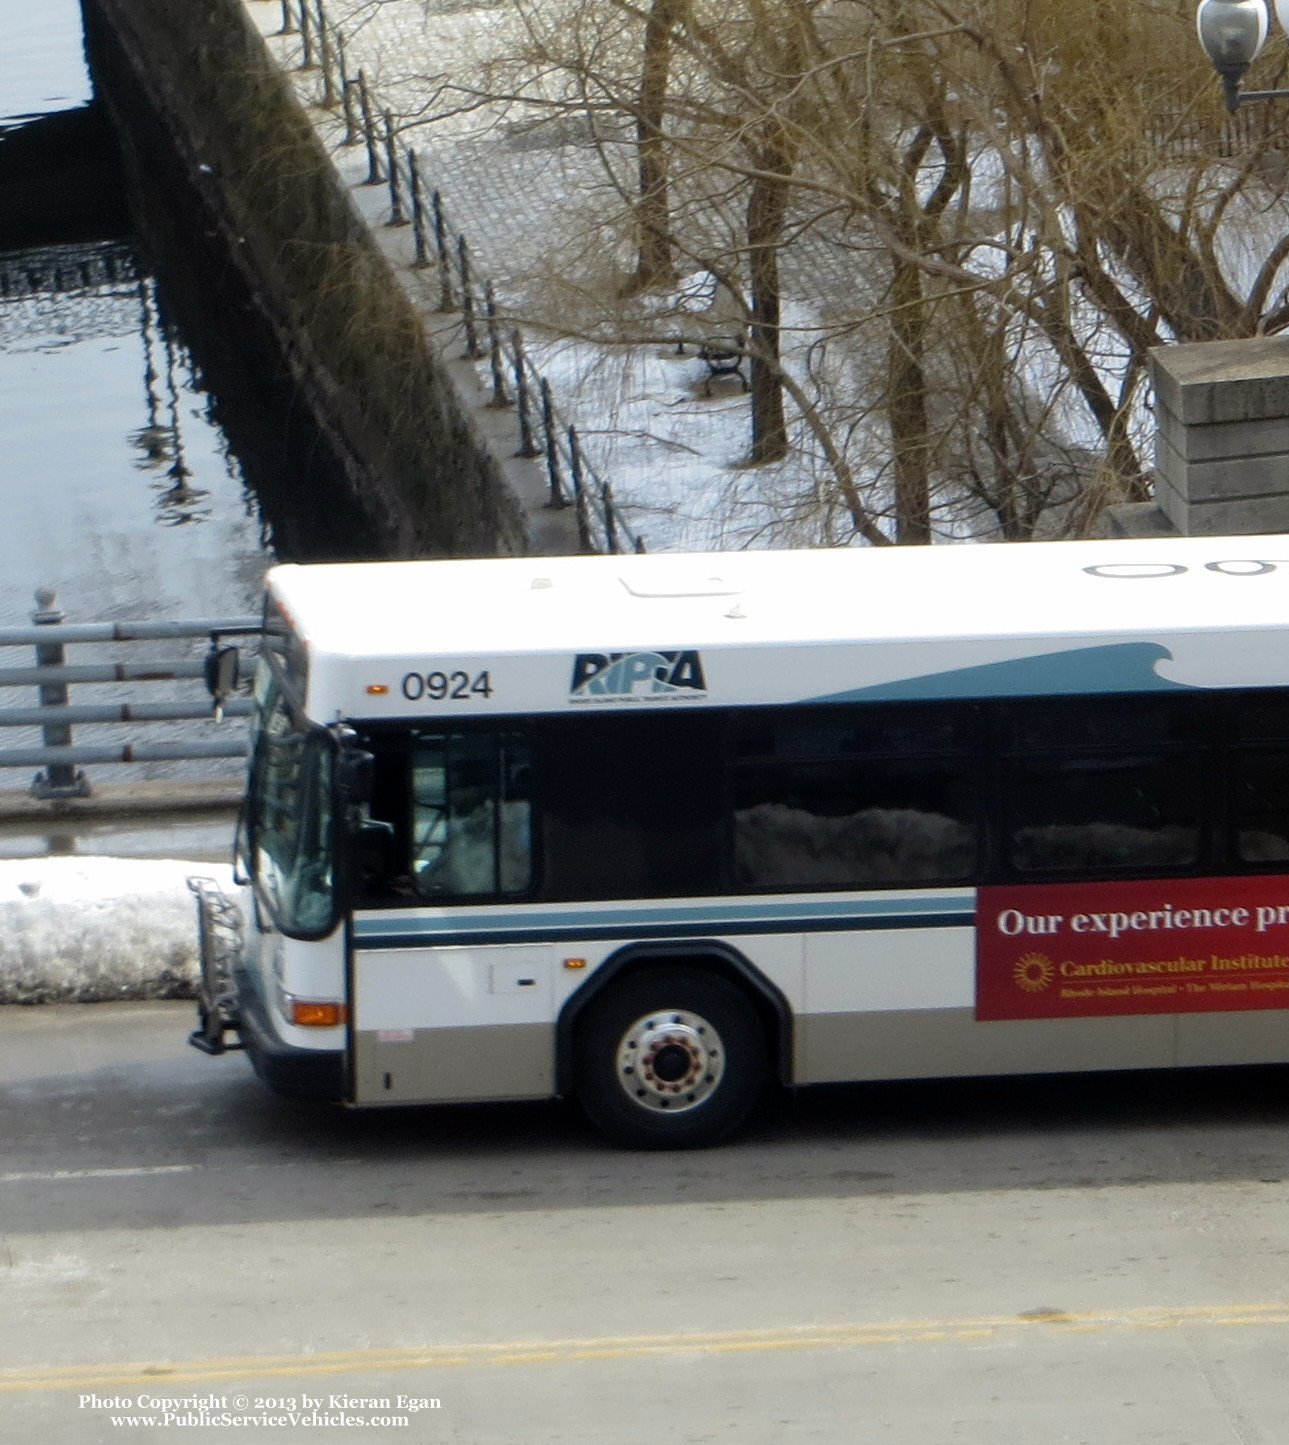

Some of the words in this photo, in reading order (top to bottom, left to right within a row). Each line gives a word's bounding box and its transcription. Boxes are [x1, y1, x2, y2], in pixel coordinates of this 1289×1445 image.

[402, 670, 494, 700] 0924
[998, 909, 1063, 935] Our
[1070, 904, 1250, 937] experience
[1060, 958, 1207, 978] Cardiovascular
